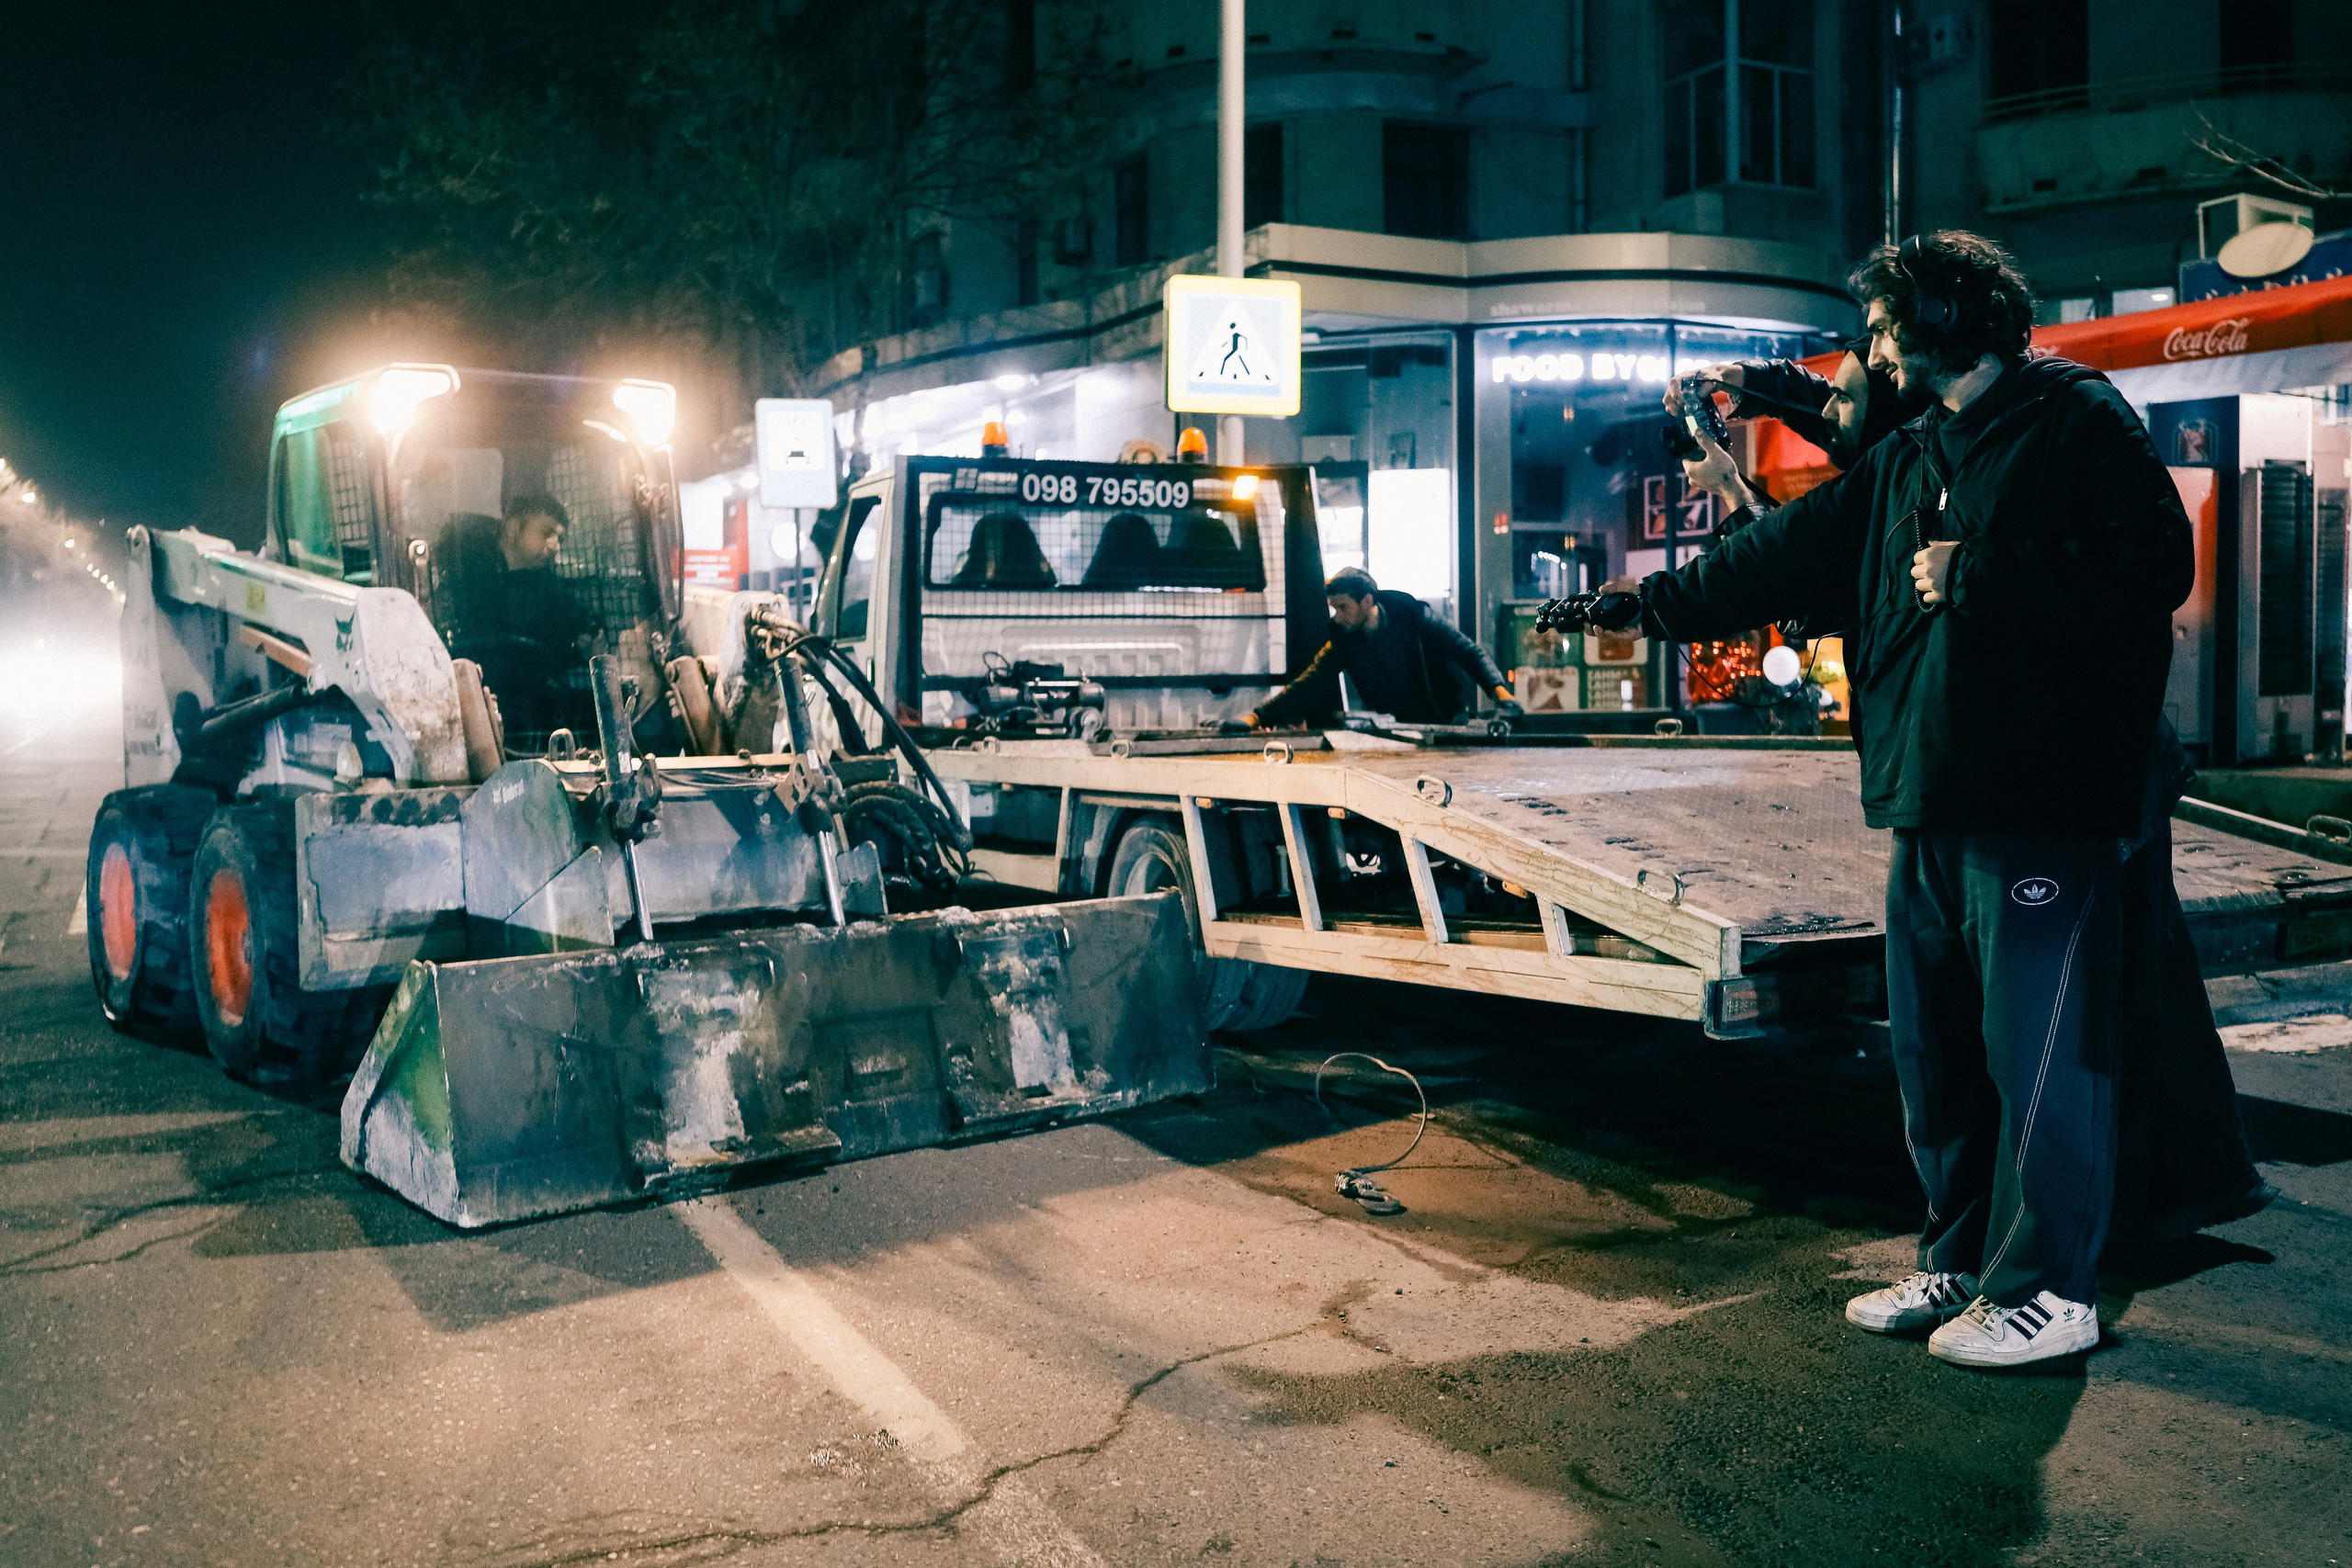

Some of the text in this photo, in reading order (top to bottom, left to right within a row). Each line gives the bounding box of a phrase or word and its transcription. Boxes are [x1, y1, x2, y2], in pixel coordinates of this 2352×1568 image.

[1492, 354, 1584, 383] FOOD
[1023, 473, 1190, 508] 098 795509
